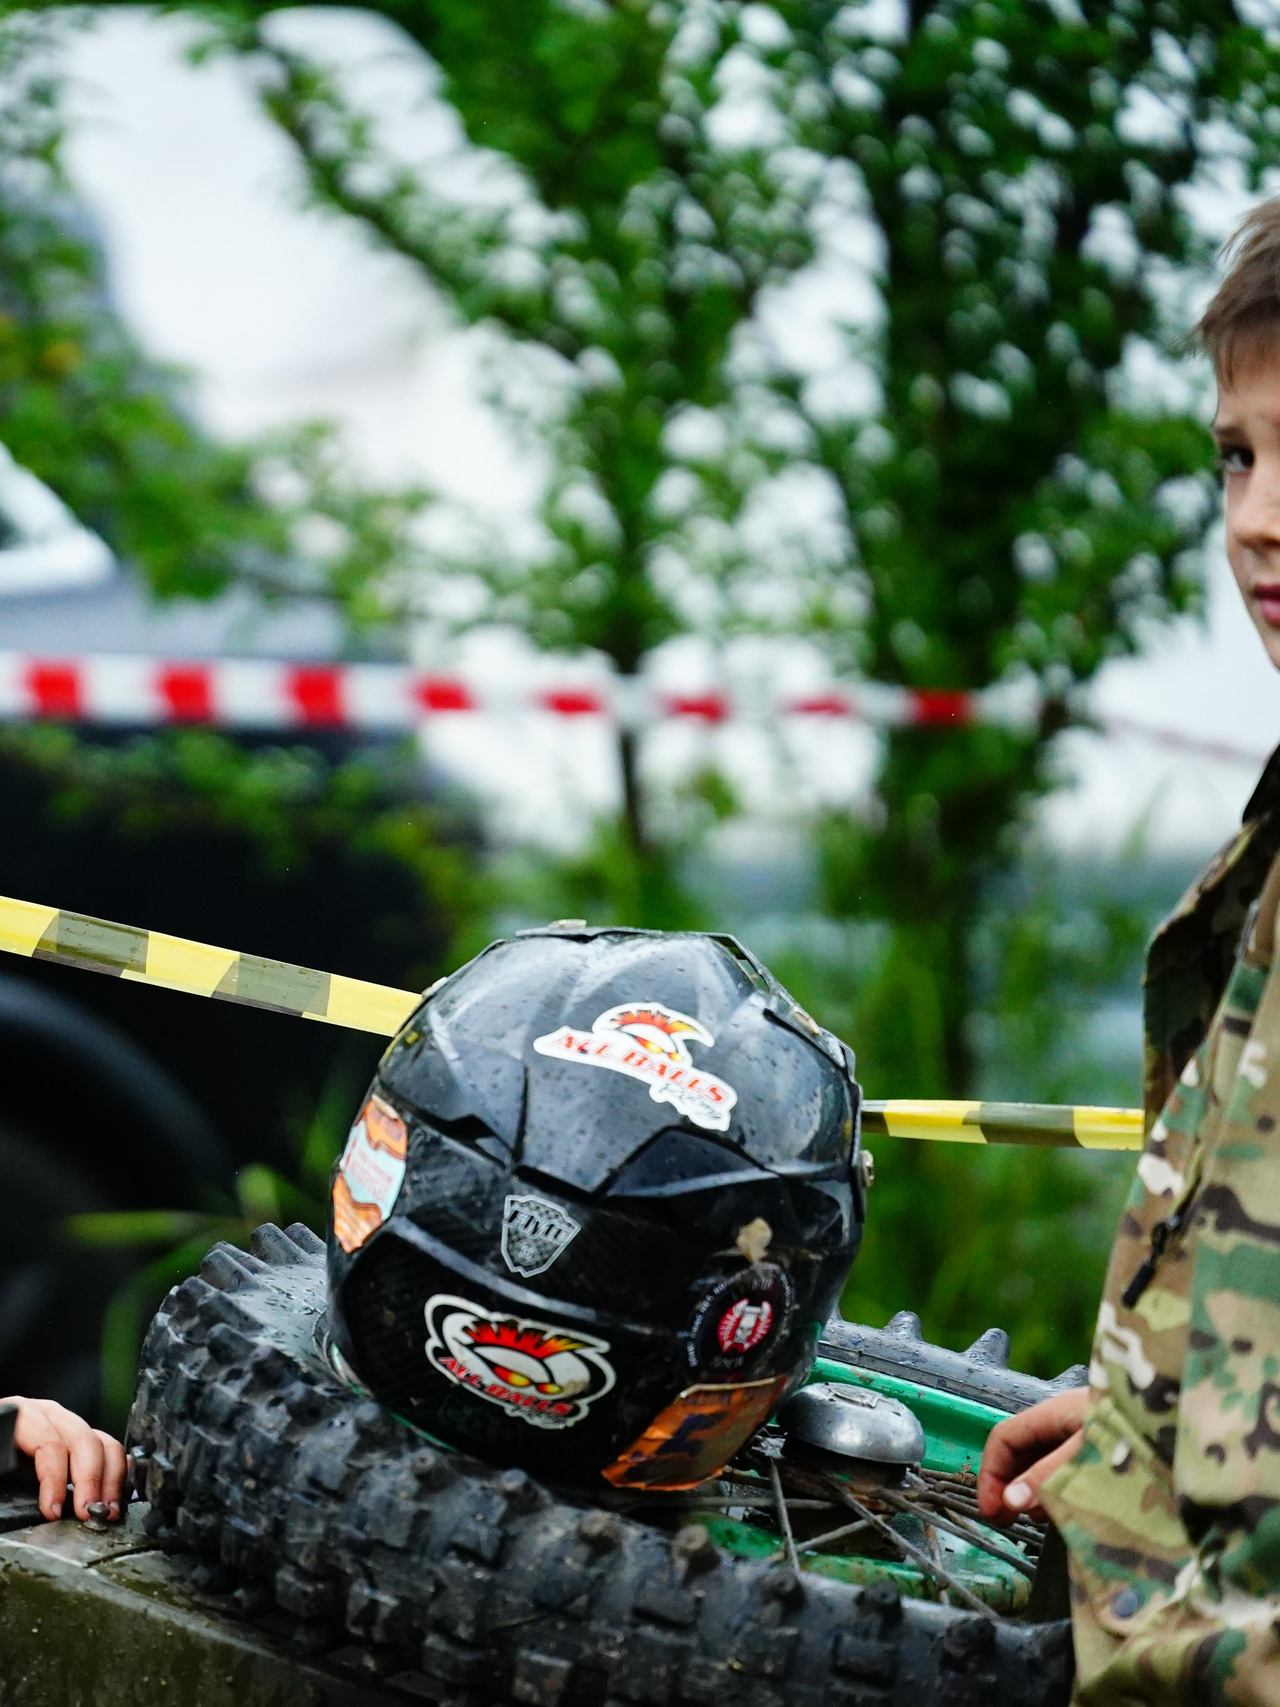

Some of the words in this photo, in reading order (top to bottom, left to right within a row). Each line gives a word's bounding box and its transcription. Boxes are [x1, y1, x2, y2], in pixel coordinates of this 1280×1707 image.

[548, 1034, 613, 1057] ALL
[619, 1049, 729, 1107] BALLS
[438, 1356, 483, 1388] ALL
[483, 1384, 574, 1416] BALLS
